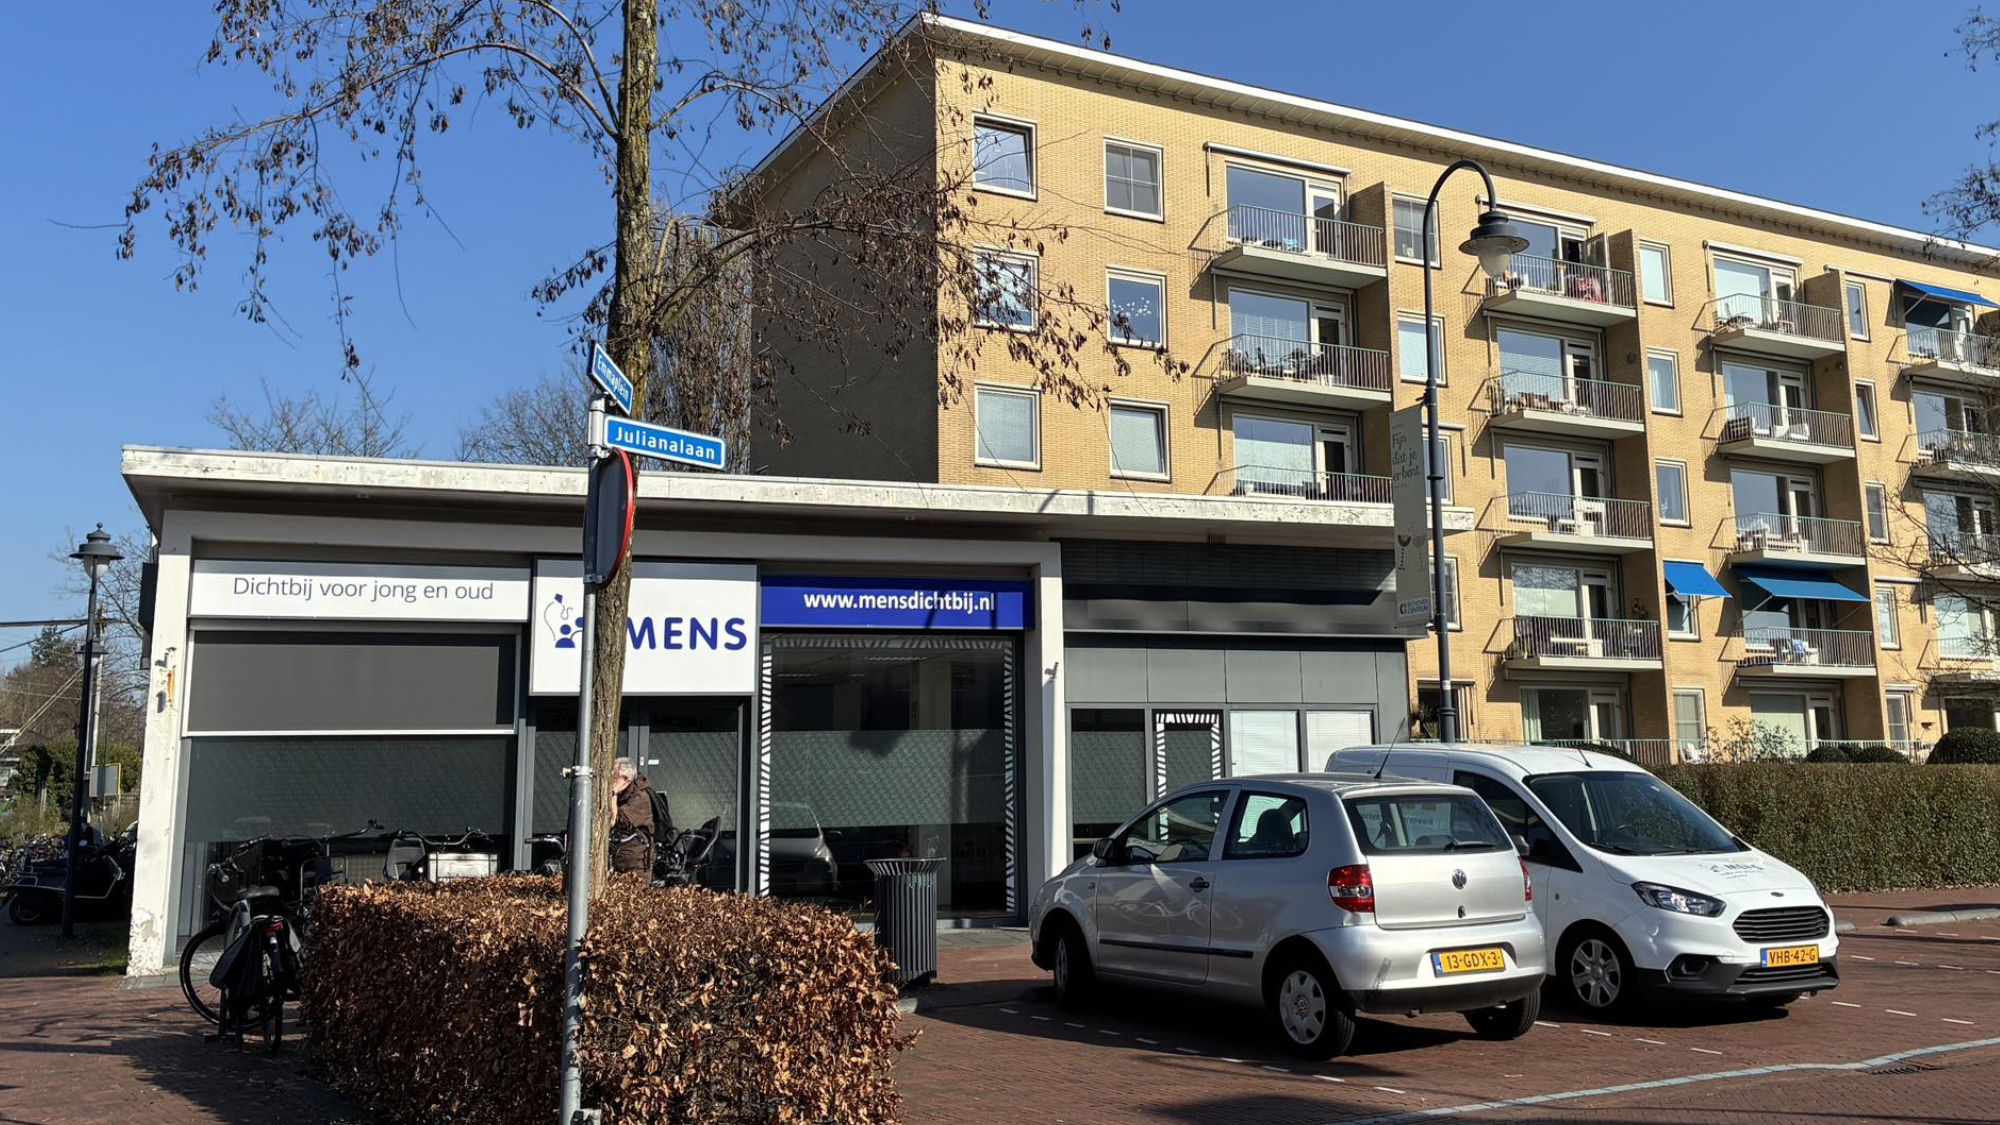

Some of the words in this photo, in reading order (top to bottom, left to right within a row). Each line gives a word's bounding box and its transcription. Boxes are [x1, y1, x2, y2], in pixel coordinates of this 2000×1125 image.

[597, 356, 629, 402] Emmaplein
[616, 427, 715, 460] Julianalaan
[234, 577, 313, 601] Dichtbij
[319, 582, 367, 597] voor
[370, 580, 417, 603] jong
[423, 584, 448, 599] en
[454, 582, 494, 599] oud
[803, 591, 995, 615] www.mensdichtbij.nl
[626, 616, 747, 651] MENS
[1769, 948, 1816, 965] VHB-42-G
